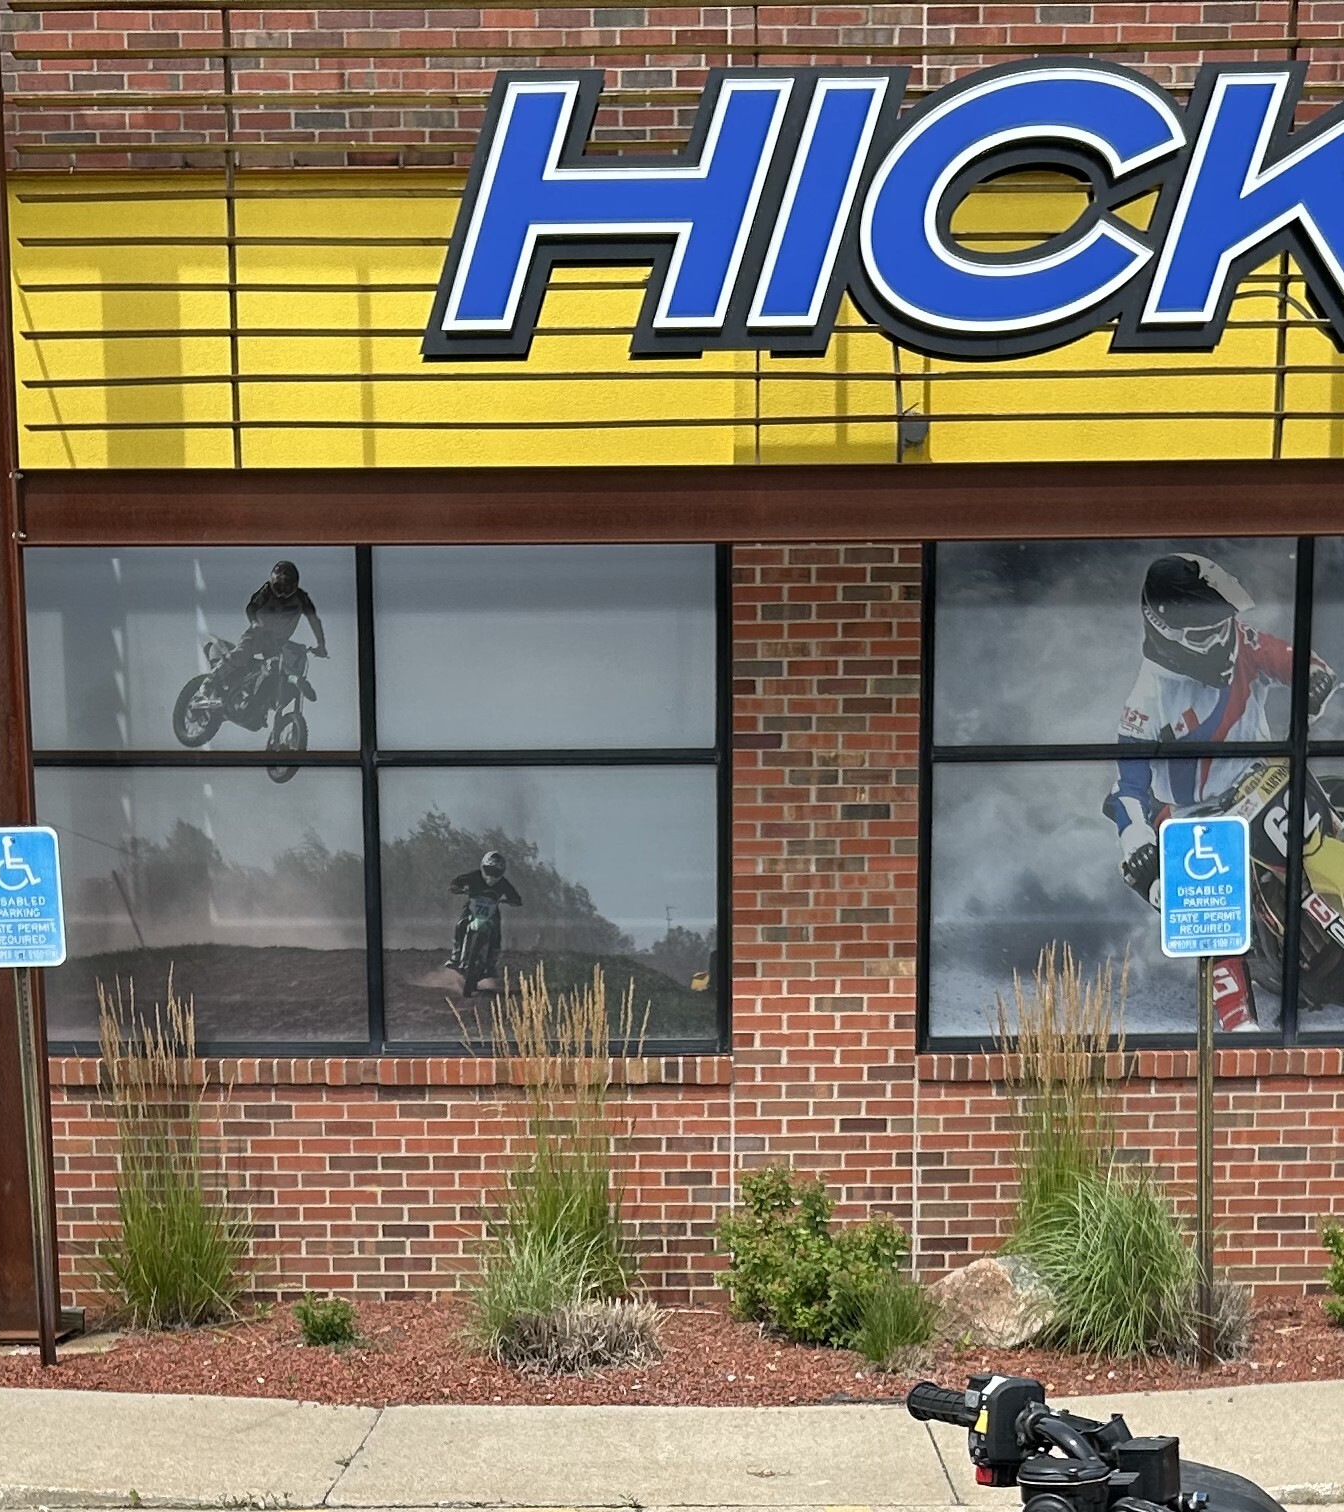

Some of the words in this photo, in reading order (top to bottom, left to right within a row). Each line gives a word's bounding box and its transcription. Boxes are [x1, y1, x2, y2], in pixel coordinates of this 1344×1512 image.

[1177, 885, 1233, 897] DISABLED
[1183, 896, 1227, 907] PARKING
[1169, 912, 1199, 924] STATE
[1203, 911, 1242, 922] PERMIT
[18, 922, 56, 933] PERMIT
[1179, 922, 1232, 934] REQUIRED
